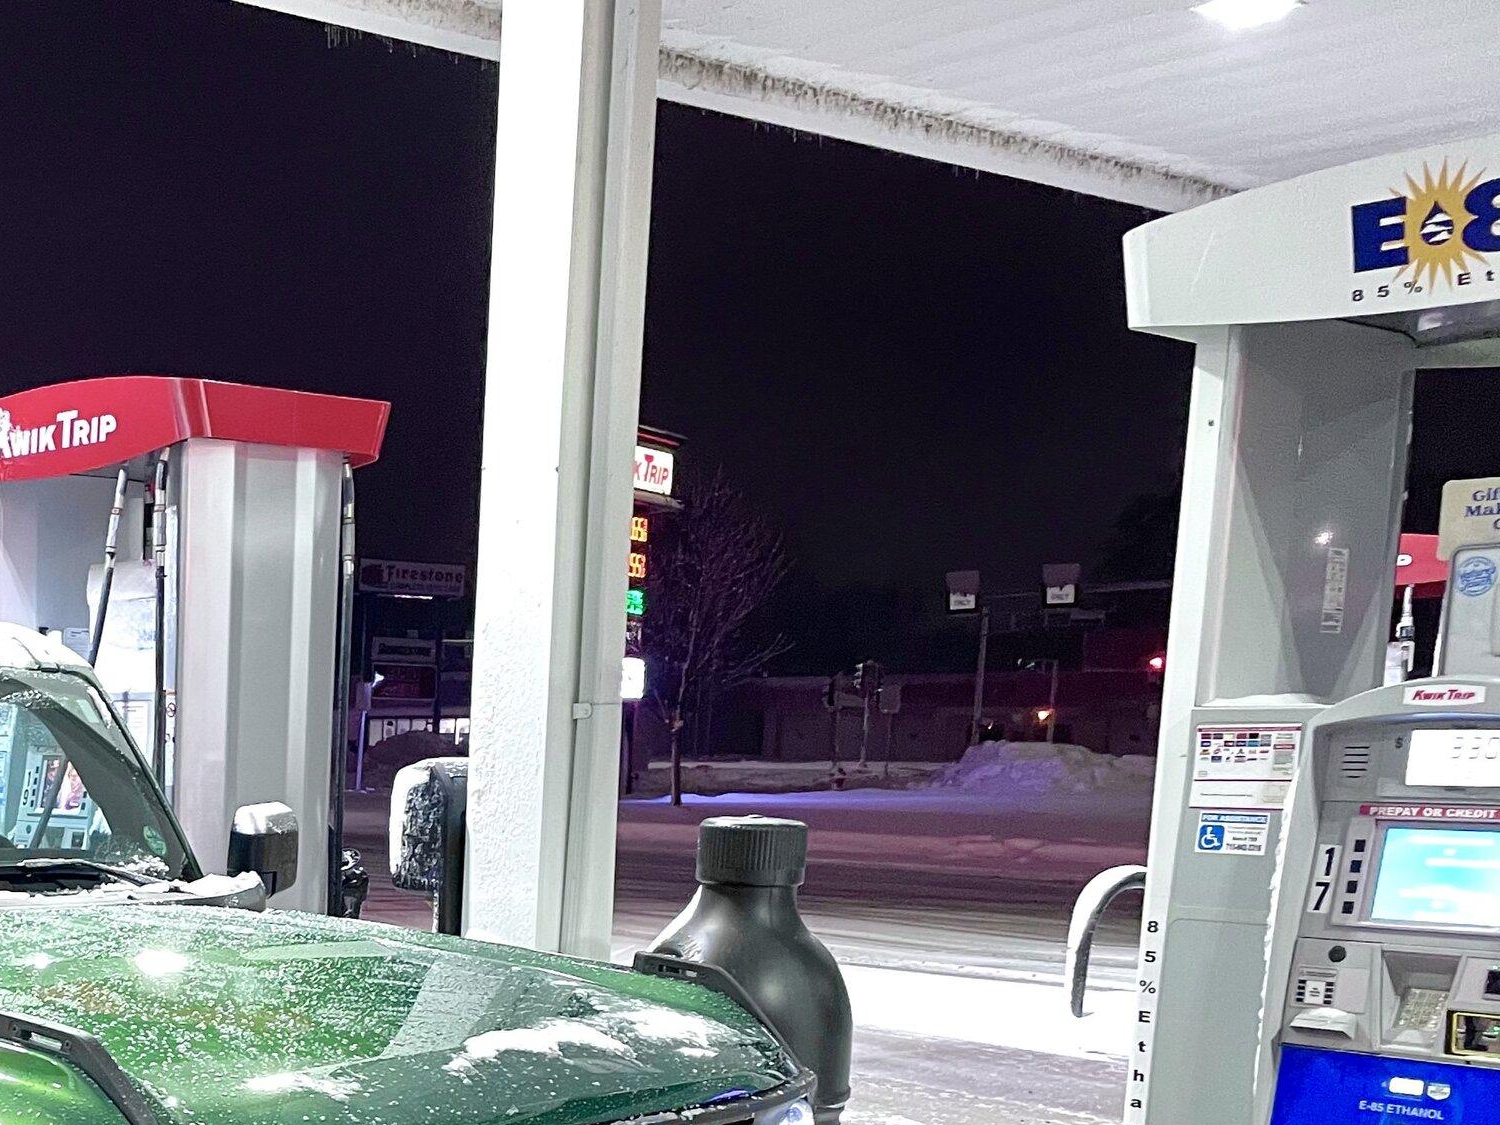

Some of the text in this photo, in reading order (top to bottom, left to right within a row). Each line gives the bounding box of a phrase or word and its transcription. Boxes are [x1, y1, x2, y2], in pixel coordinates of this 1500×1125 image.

[1352, 281, 1423, 302] 85%
[56, 410, 117, 449] TRIP
[644, 453, 669, 485] TRIP
[1369, 806, 1498, 819] PREPAY OR CREDIT
[1358, 1100, 1445, 1121] E-85 ETHANOL
